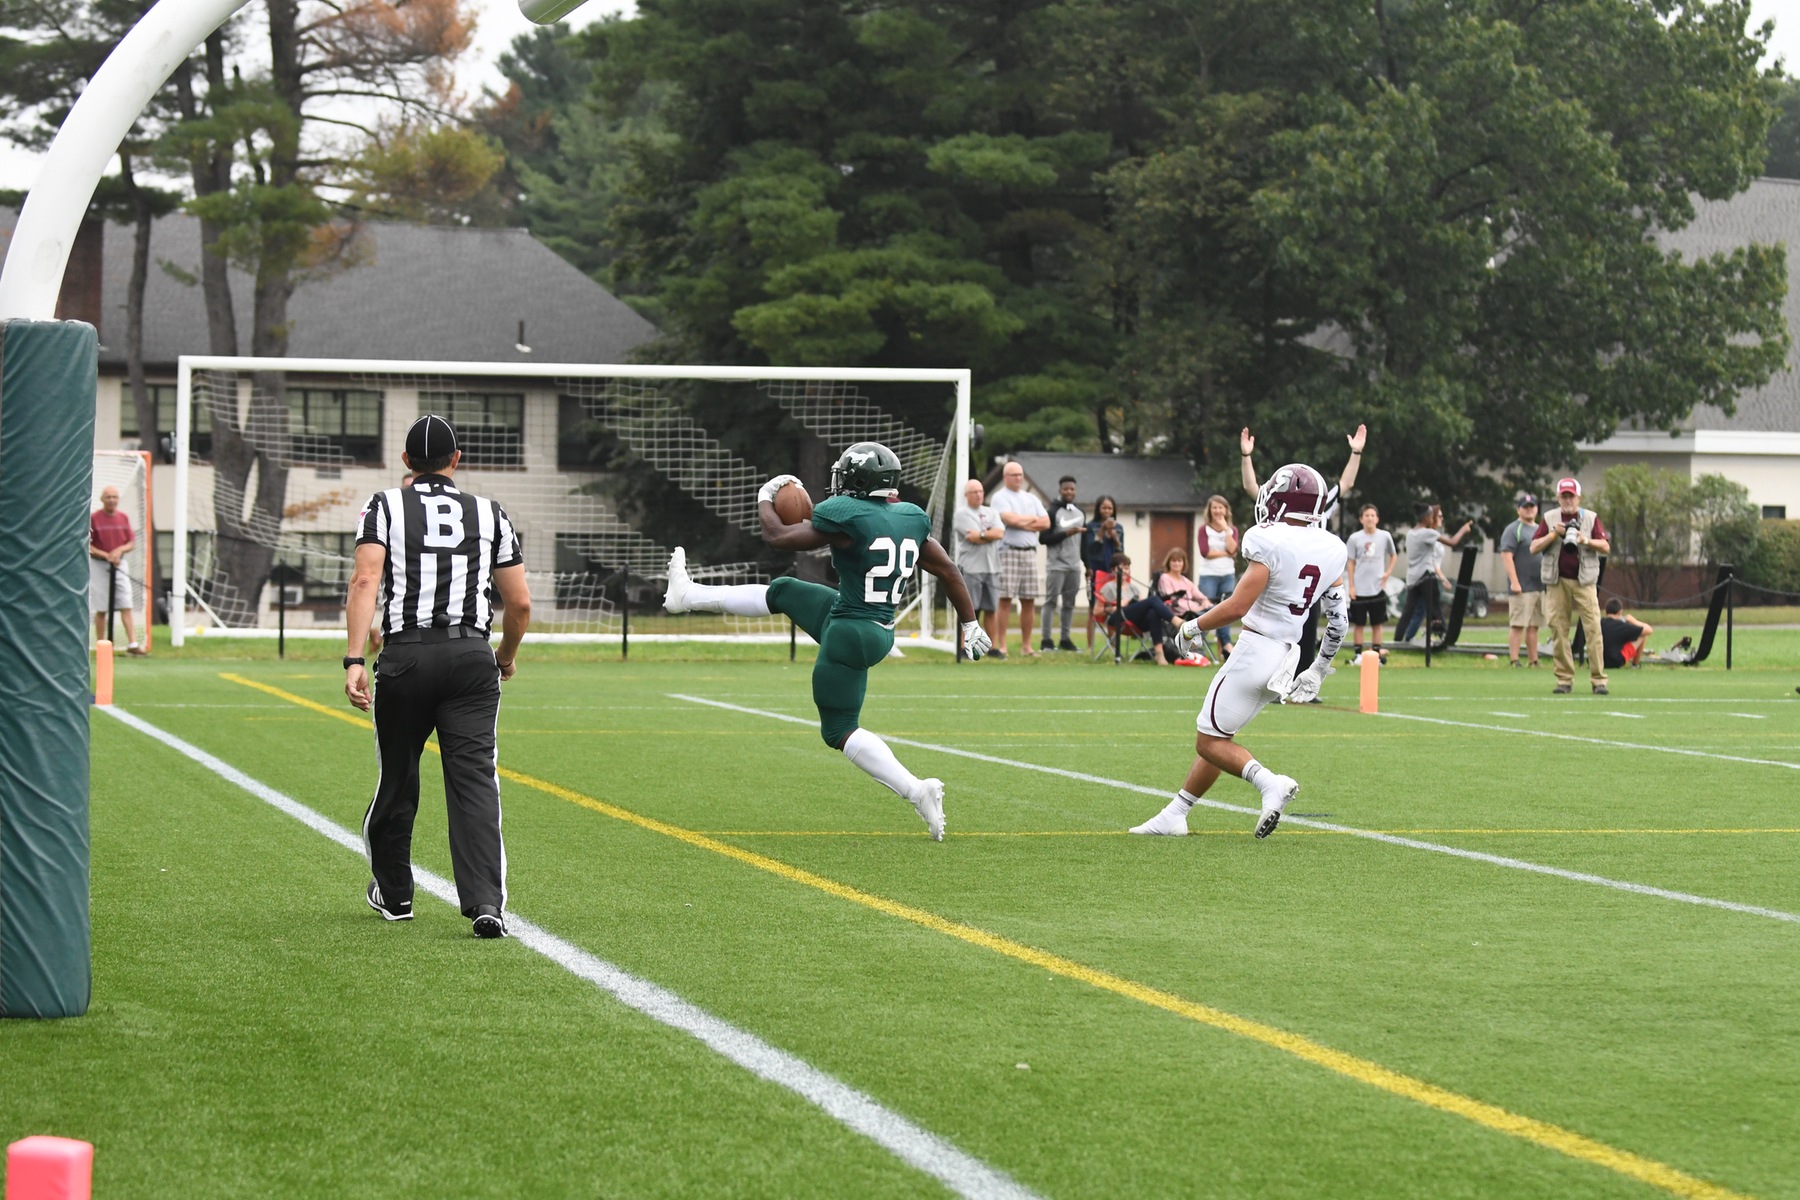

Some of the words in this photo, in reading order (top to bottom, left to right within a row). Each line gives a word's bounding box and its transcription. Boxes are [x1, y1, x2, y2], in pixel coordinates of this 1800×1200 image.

[420, 495, 465, 548] B
[864, 537, 920, 605] 28
[1288, 564, 1322, 616] 3
